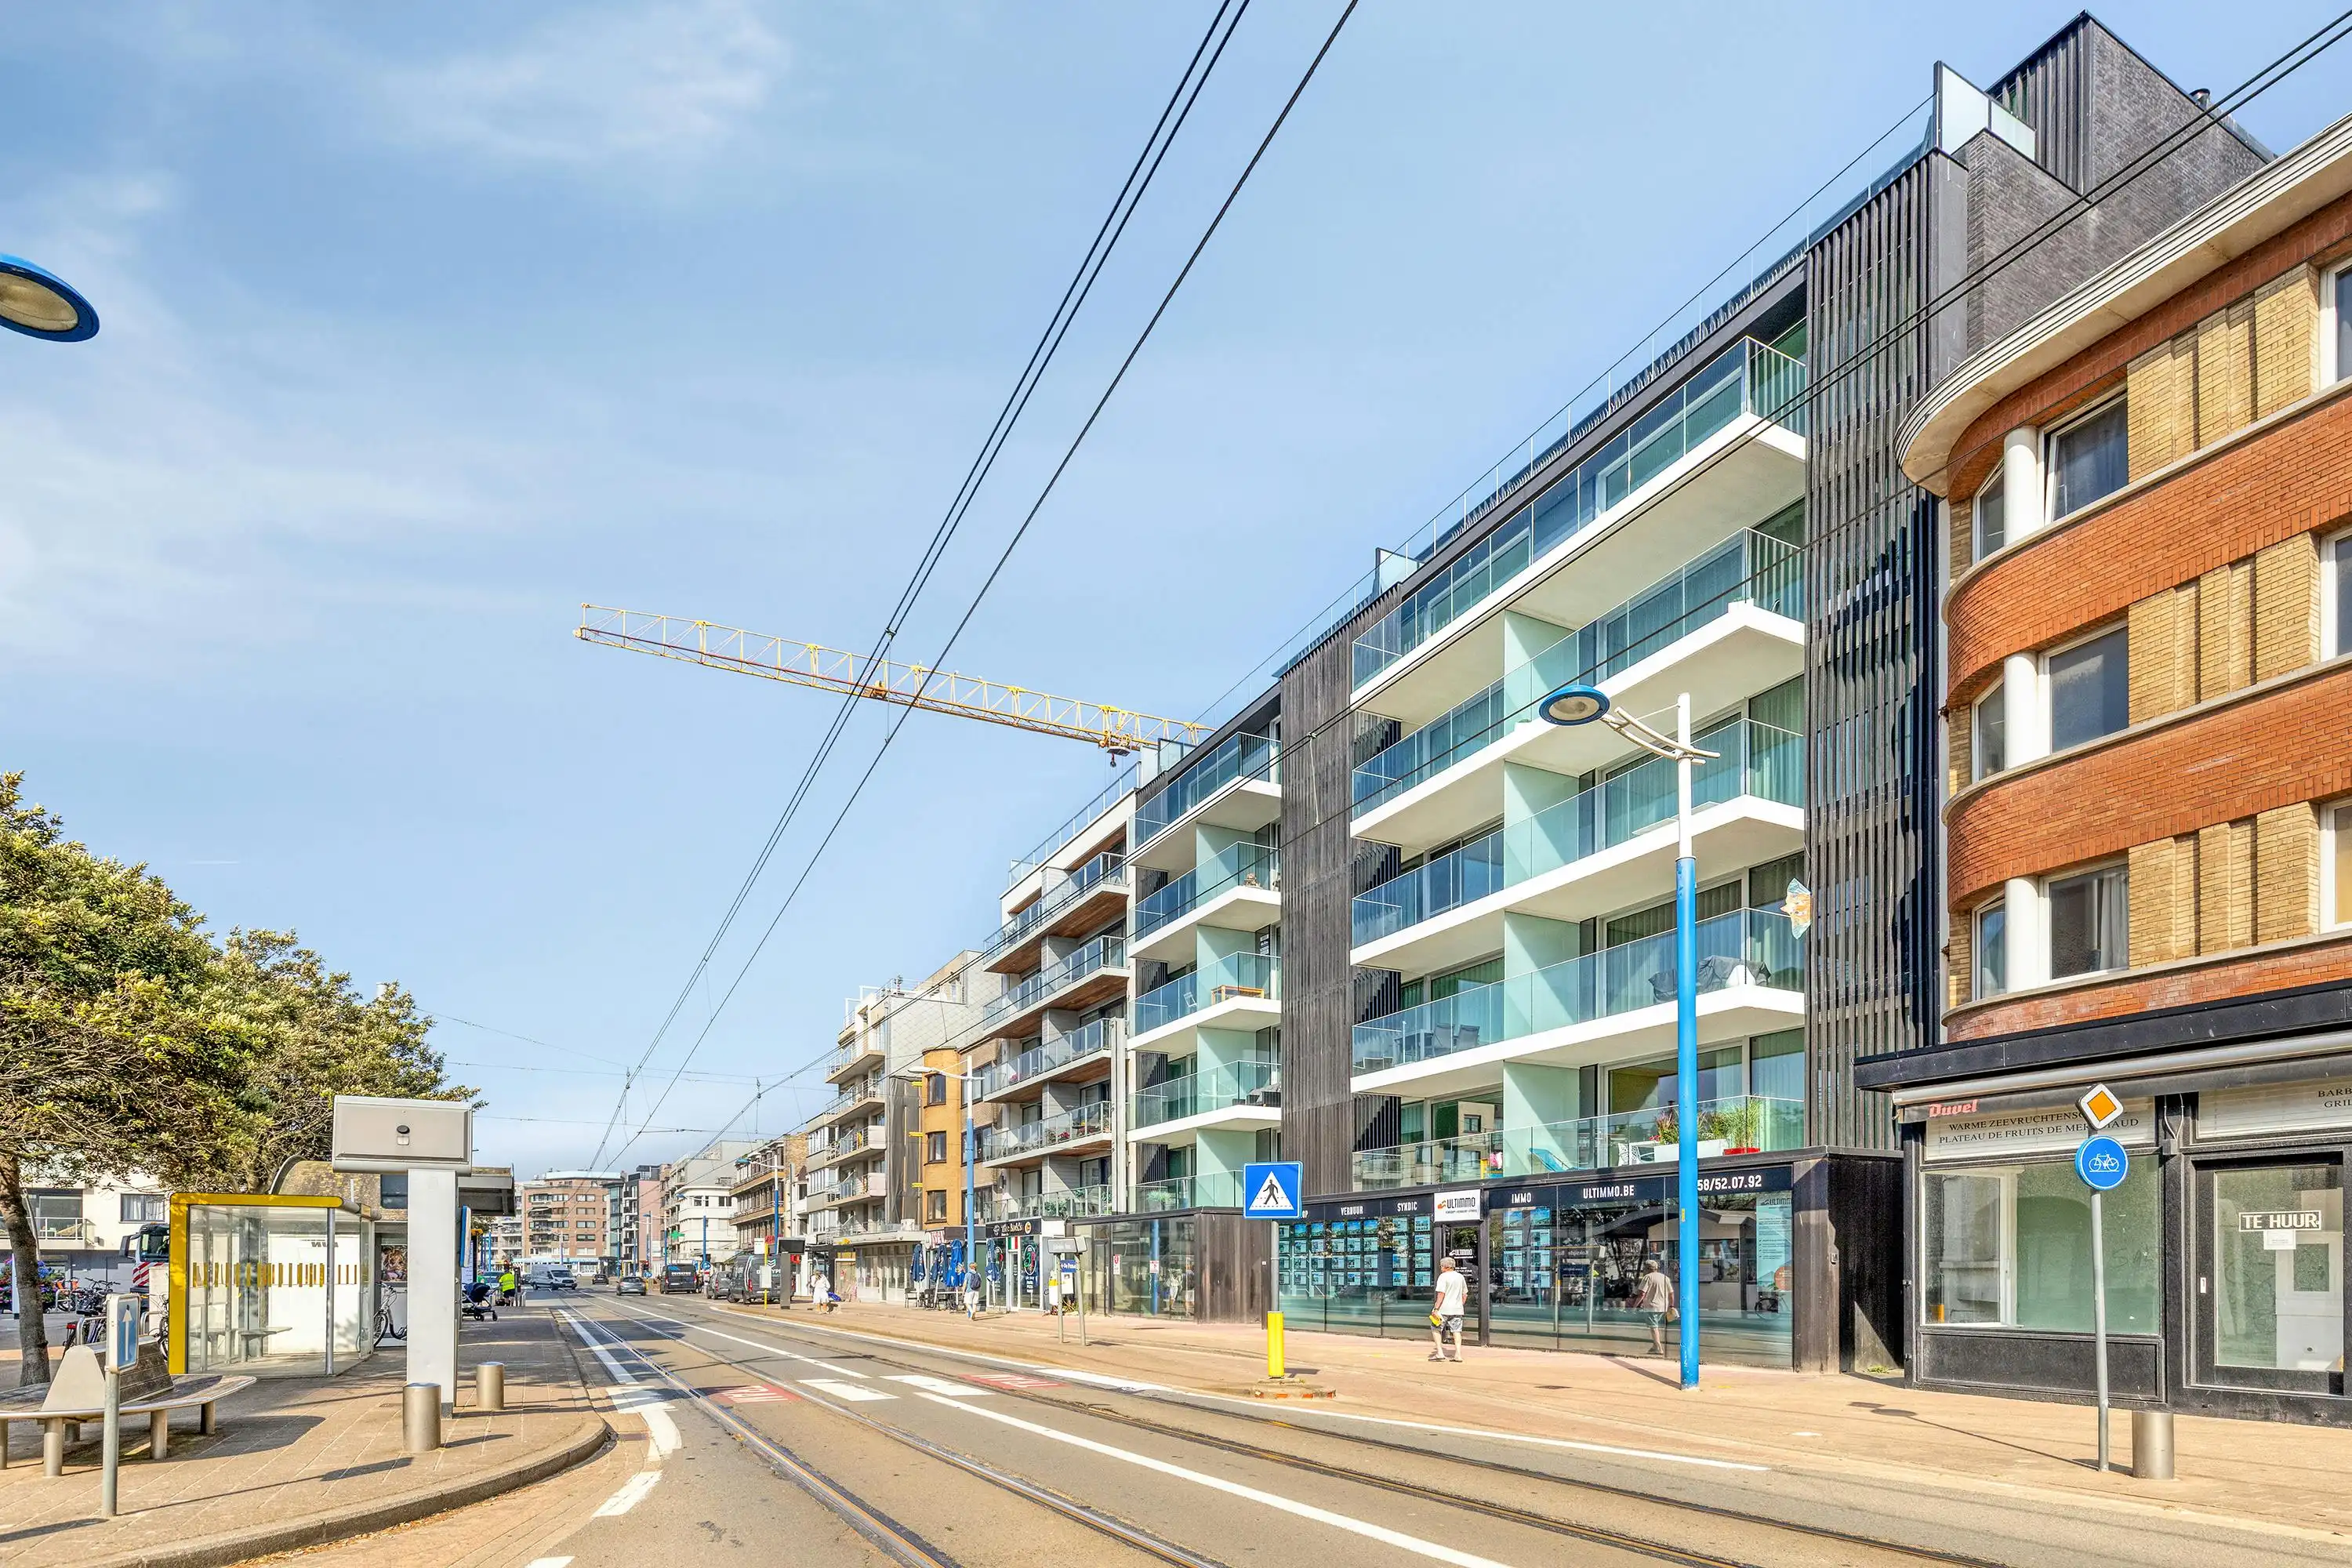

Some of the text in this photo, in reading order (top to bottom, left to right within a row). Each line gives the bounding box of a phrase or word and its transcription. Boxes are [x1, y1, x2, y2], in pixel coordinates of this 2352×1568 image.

[1929, 1099, 1978, 1117] Duvel
[1949, 1120, 1987, 1131] WARME
[1940, 1132, 1985, 1144] PLATEAU
[1988, 1131, 2002, 1140] DE
[2005, 1127, 2044, 1138] FRUITS
[2047, 1126, 2063, 1134] DE
[1511, 1192, 1532, 1204] IMMO
[1583, 1185, 1635, 1200] ULTIMMO.BE
[1397, 1201, 1417, 1212] SYNDIC
[1446, 1196, 1475, 1209] ULTIMMO
[1340, 1205, 1363, 1216] VERHUUR
[2242, 1213, 2318, 1229] TE HUUR
